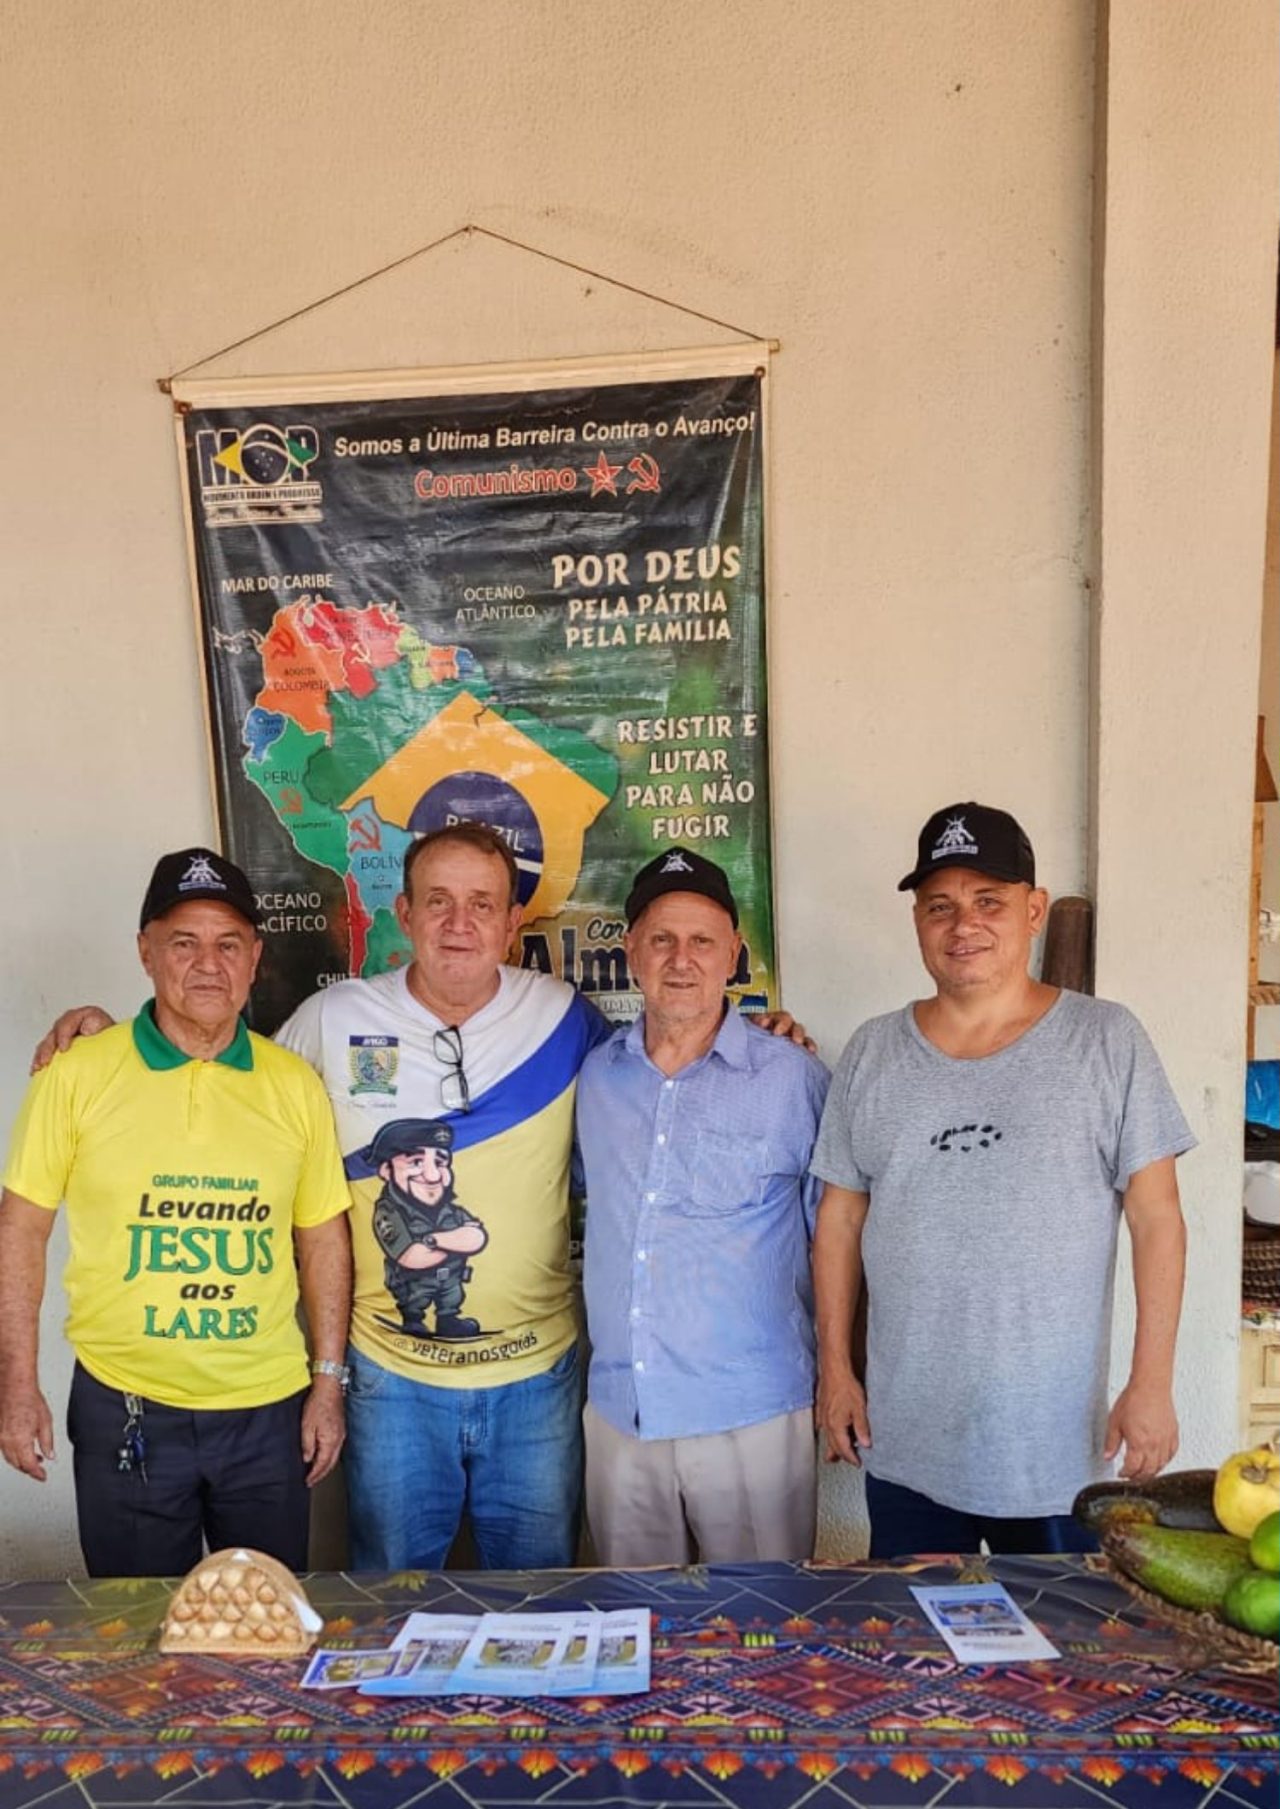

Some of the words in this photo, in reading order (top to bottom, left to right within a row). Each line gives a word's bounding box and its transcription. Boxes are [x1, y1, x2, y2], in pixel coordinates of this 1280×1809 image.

[334, 436, 402, 457] Somos
[409, 437, 420, 452] a
[427, 427, 490, 451] Última
[496, 423, 576, 447] Barreira
[582, 421, 649, 441] Contra
[655, 421, 668, 437] o
[673, 411, 755, 438] Avanço!
[414, 464, 577, 498] Comunismo
[551, 552, 631, 589] POR
[645, 545, 741, 583] DEUS
[221, 577, 255, 593] MAR
[258, 575, 279, 591] DO
[283, 573, 334, 589] CARIBE
[464, 585, 525, 601] OCEANO
[455, 603, 535, 624] ATLÂNTICO
[569, 596, 630, 621] PELA
[637, 585, 727, 616] PÁTRIA
[565, 624, 627, 648] PELA
[617, 715, 733, 743] RESISTIR
[743, 714, 757, 736] E
[649, 749, 728, 774] LUTAR
[263, 770, 300, 784] PERU
[626, 784, 694, 808] PARA
[702, 774, 755, 803] NÃO
[446, 813, 524, 852] BZIL
[652, 815, 729, 839] FUGIR
[257, 913, 327, 933] CÍFICO
[152, 1175, 199, 1189] GRUPO
[202, 1176, 259, 1191] FAMILIAR
[139, 1193, 271, 1222] Levando
[123, 1224, 274, 1282] JESUS
[180, 1283, 236, 1300] aos
[143, 1305, 259, 1340] LARES
